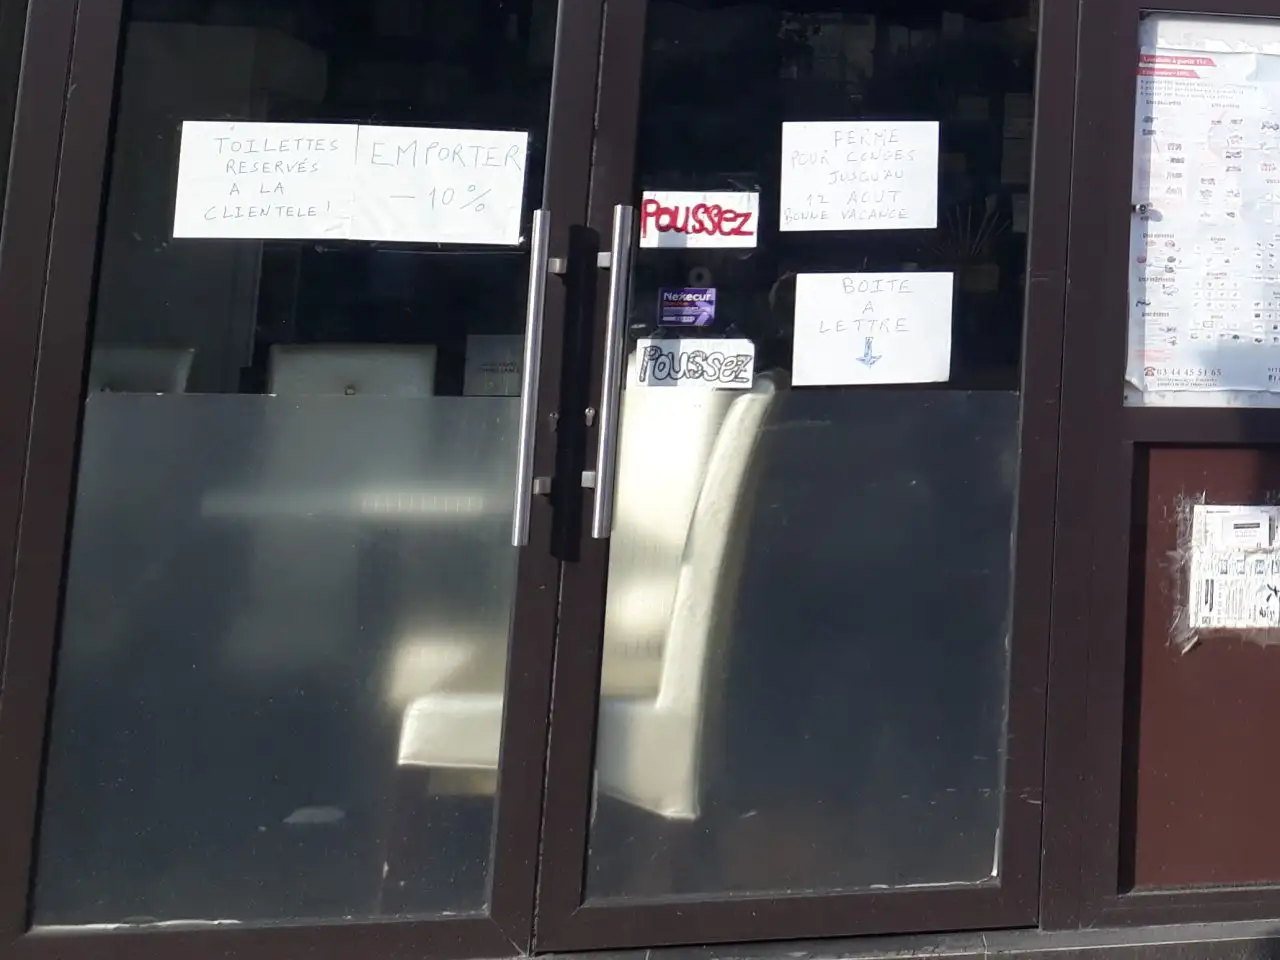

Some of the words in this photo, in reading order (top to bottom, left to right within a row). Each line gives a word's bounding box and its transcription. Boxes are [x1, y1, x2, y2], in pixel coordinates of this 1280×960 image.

[215, 137, 339, 154] TOILETTES
[371, 141, 522, 171] EMPORTER
[791, 150, 829, 168] POUR
[226, 158, 320, 174] RESERVÉS
[229, 182, 241, 196] A
[260, 181, 285, 195] LA
[807, 193, 830, 207] 12
[642, 199, 754, 238] Poussez
[784, 208, 830, 225] BONNE
[842, 208, 909, 220] VACANCE
[842, 277, 914, 294] BOITE
[862, 300, 874, 314] A
[819, 318, 910, 333] LETTRE
